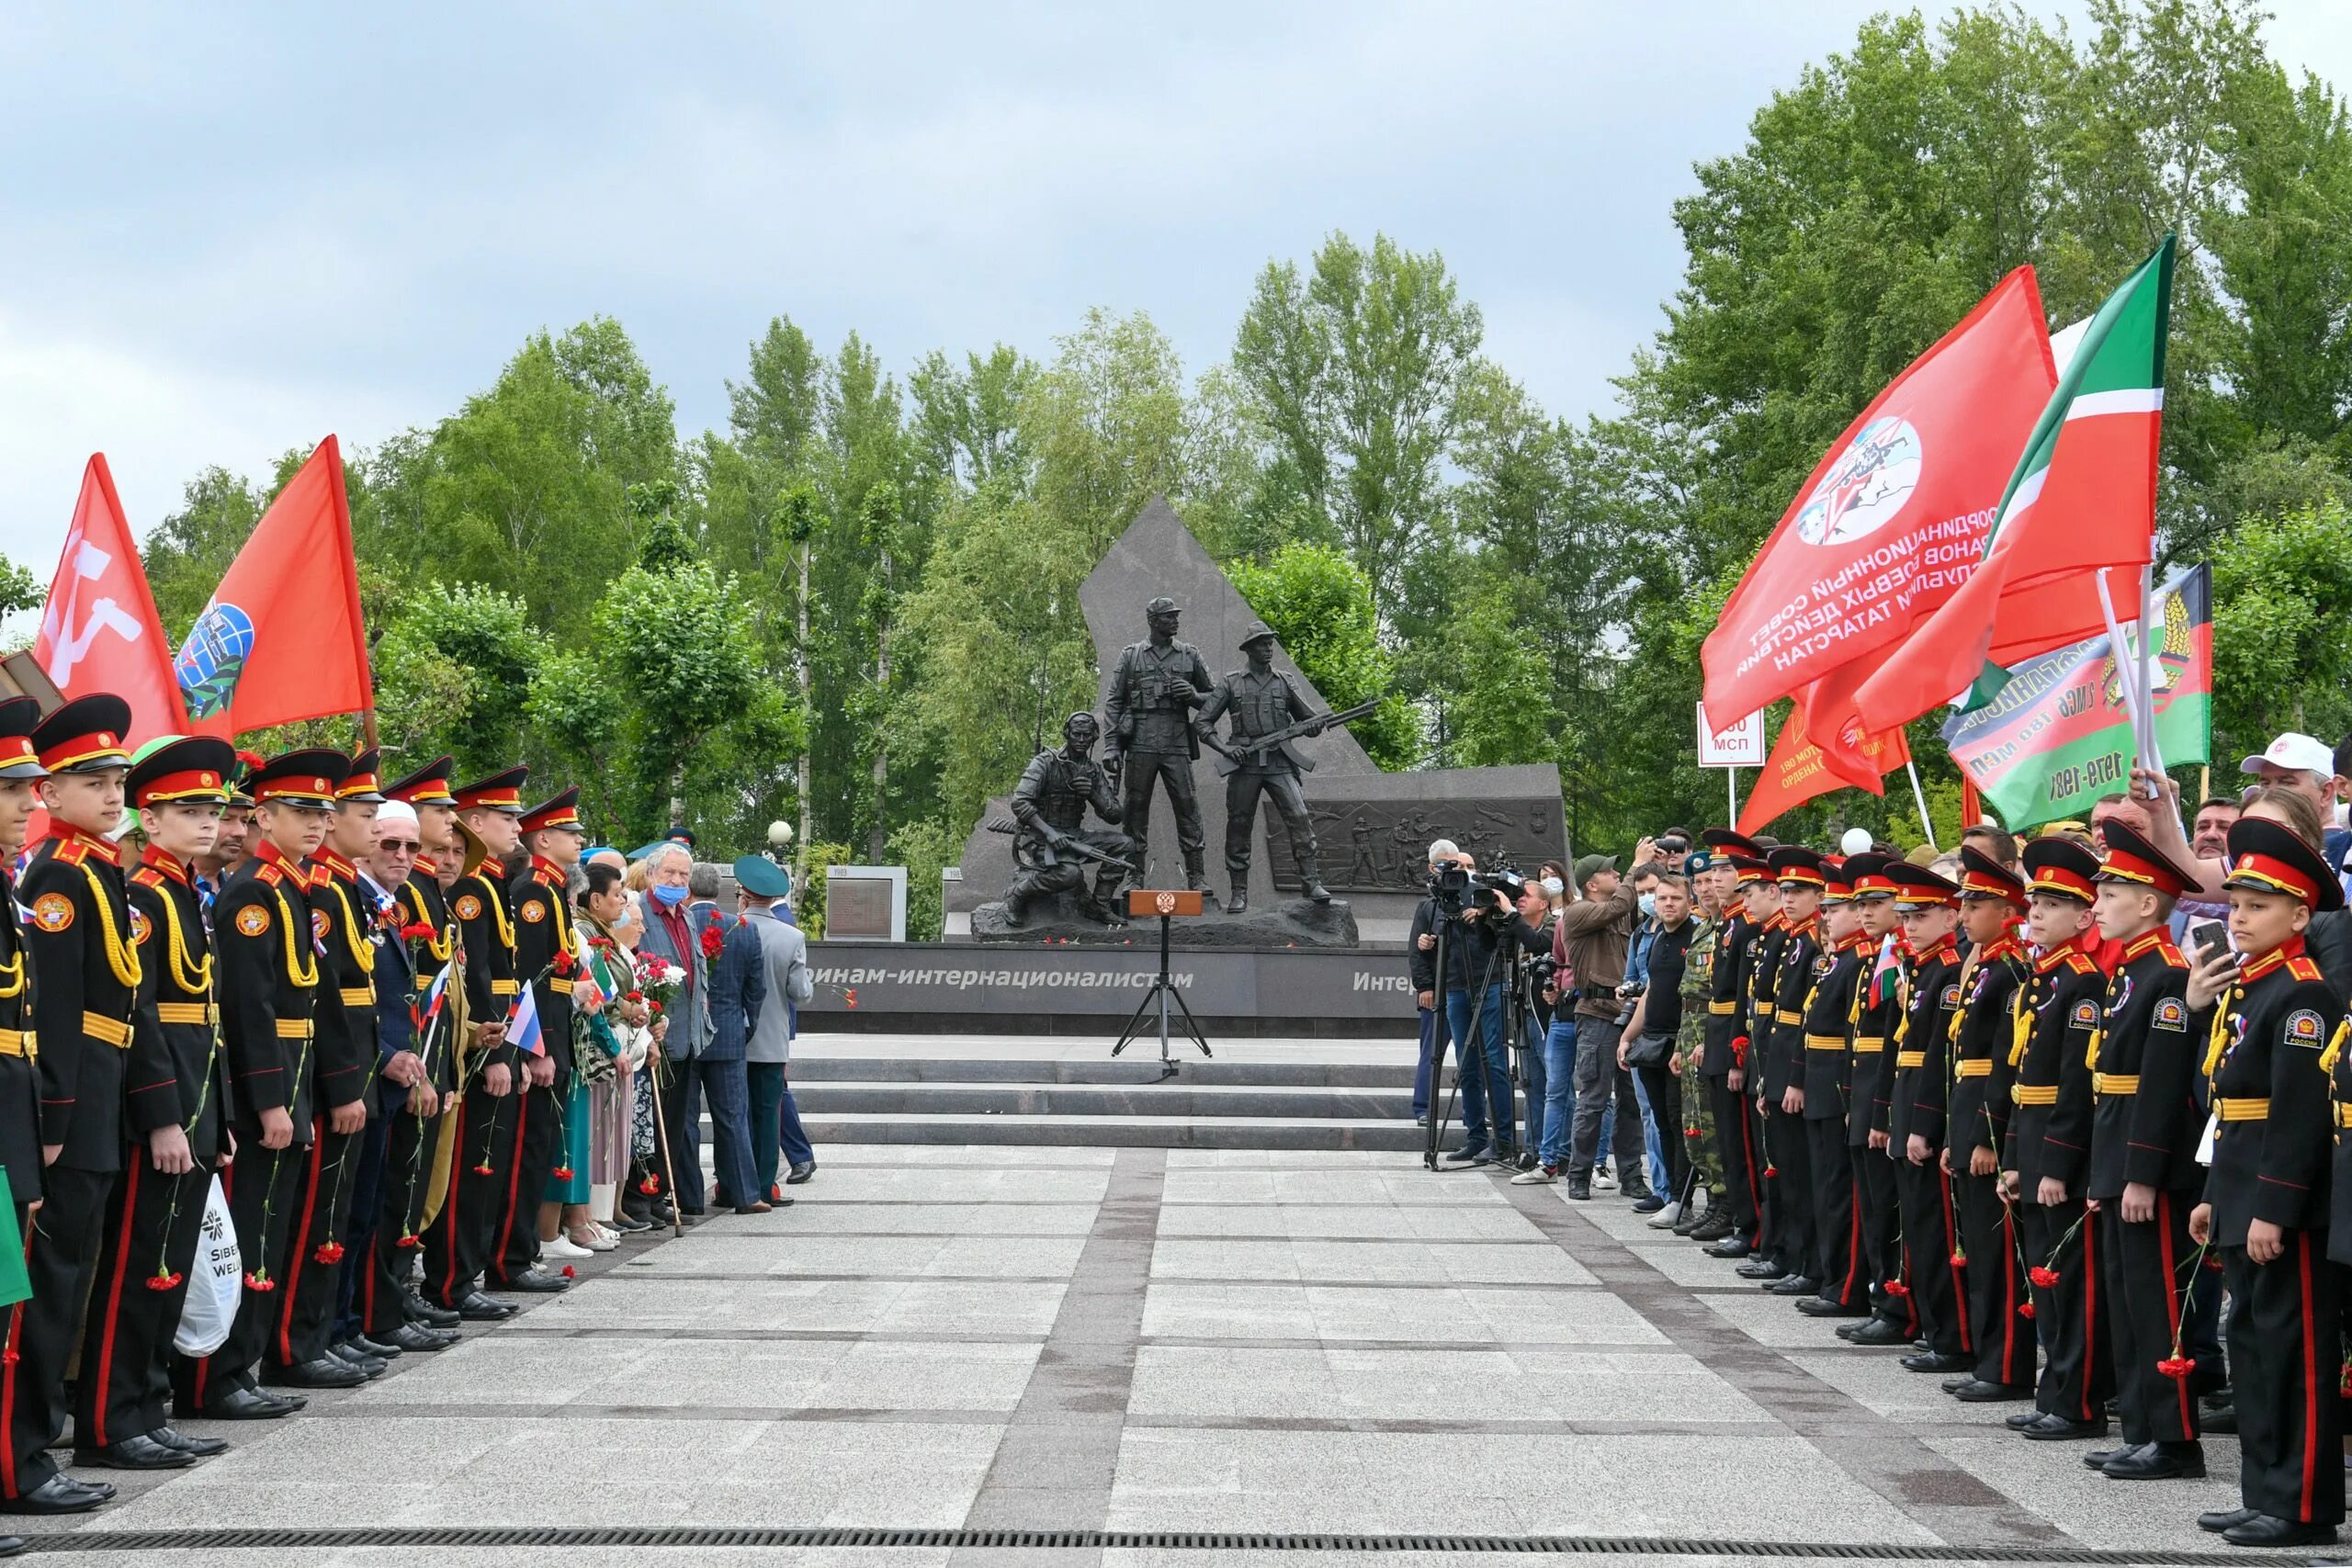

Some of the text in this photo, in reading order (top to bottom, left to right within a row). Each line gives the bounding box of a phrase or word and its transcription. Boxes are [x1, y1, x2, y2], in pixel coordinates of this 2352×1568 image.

[1714, 739, 1748, 750] МСП
[1780, 758, 1796, 773] 180
[1781, 762, 1818, 788] ОРДЕНА
